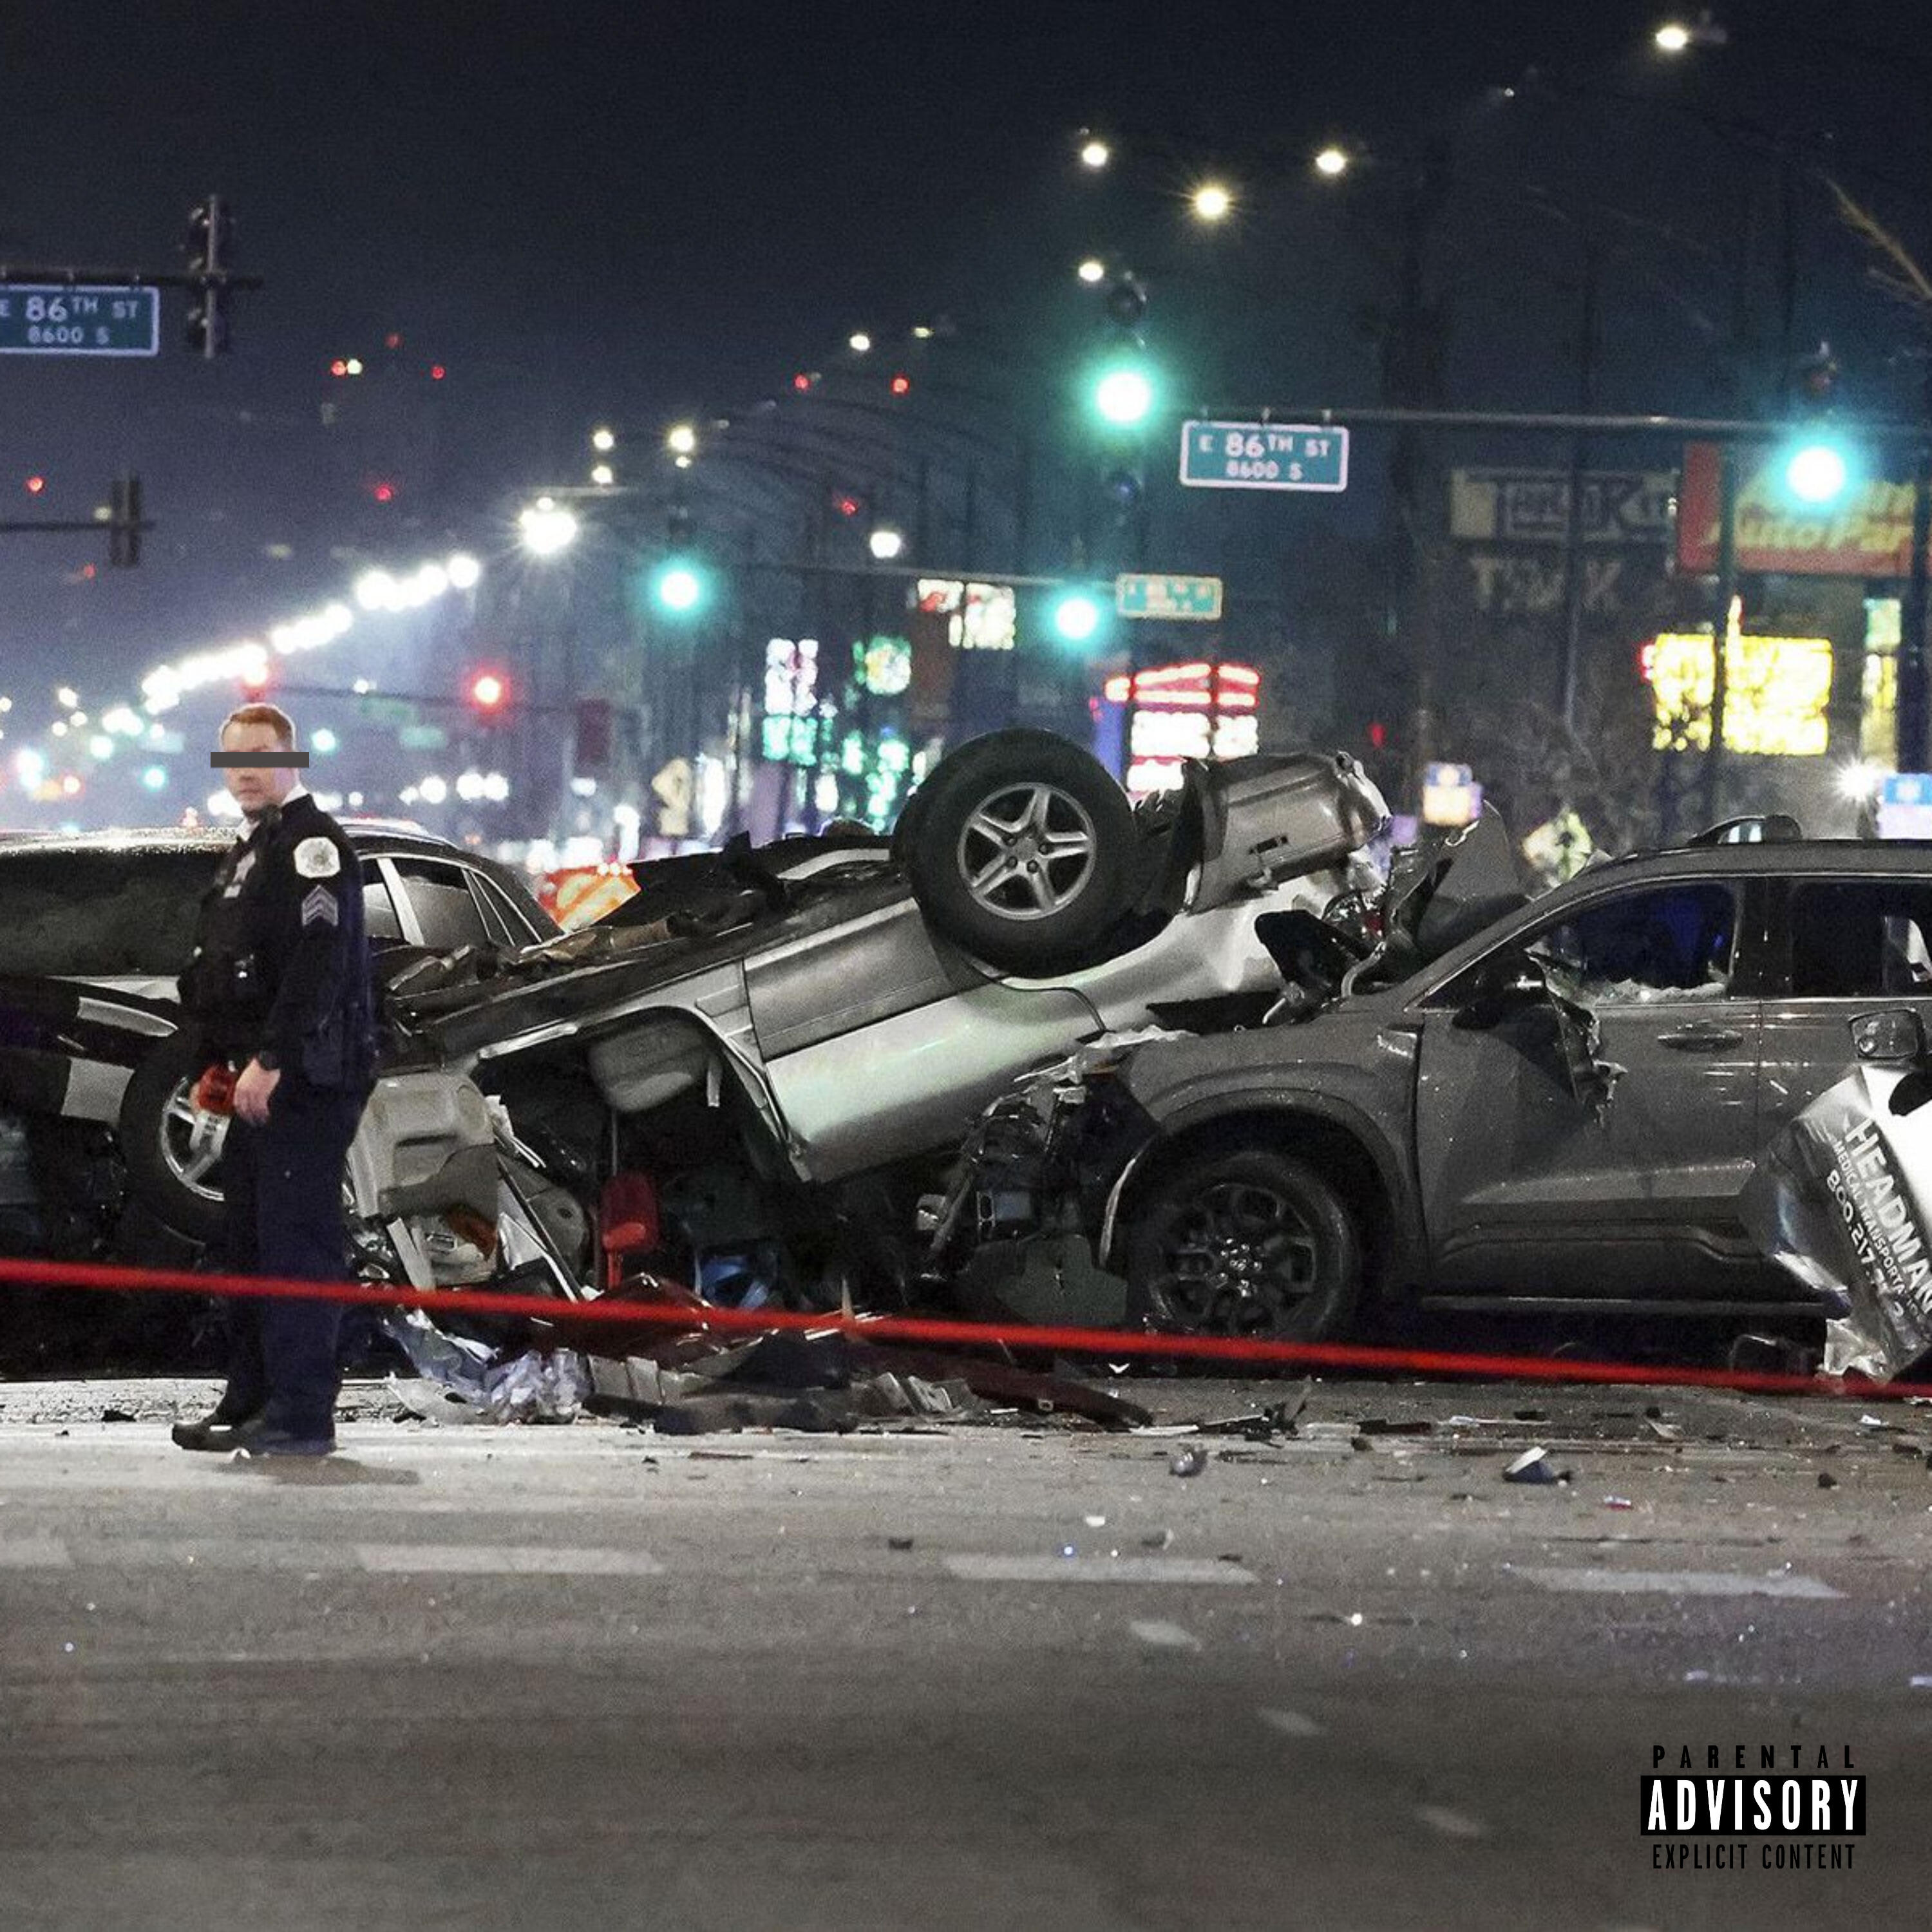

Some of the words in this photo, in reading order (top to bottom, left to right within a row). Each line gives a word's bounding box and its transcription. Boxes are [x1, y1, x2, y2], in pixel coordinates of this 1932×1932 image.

[0, 299, 10, 317] E
[26, 296, 98, 321] 86TH
[112, 300, 138, 318] ST
[28, 325, 84, 344] 8600
[97, 326, 109, 345] S
[1198, 434, 1213, 451] E
[1226, 432, 1293, 458] 86TH
[1305, 439, 1329, 457] ST
[1226, 460, 1280, 479] 8600
[1289, 462, 1302, 480] S
[1844, 1117, 1932, 1314] HEADMAN
[1833, 1141, 1863, 1200] MEDICAL
[1859, 1200, 1927, 1323] TRANSPORTAIO
